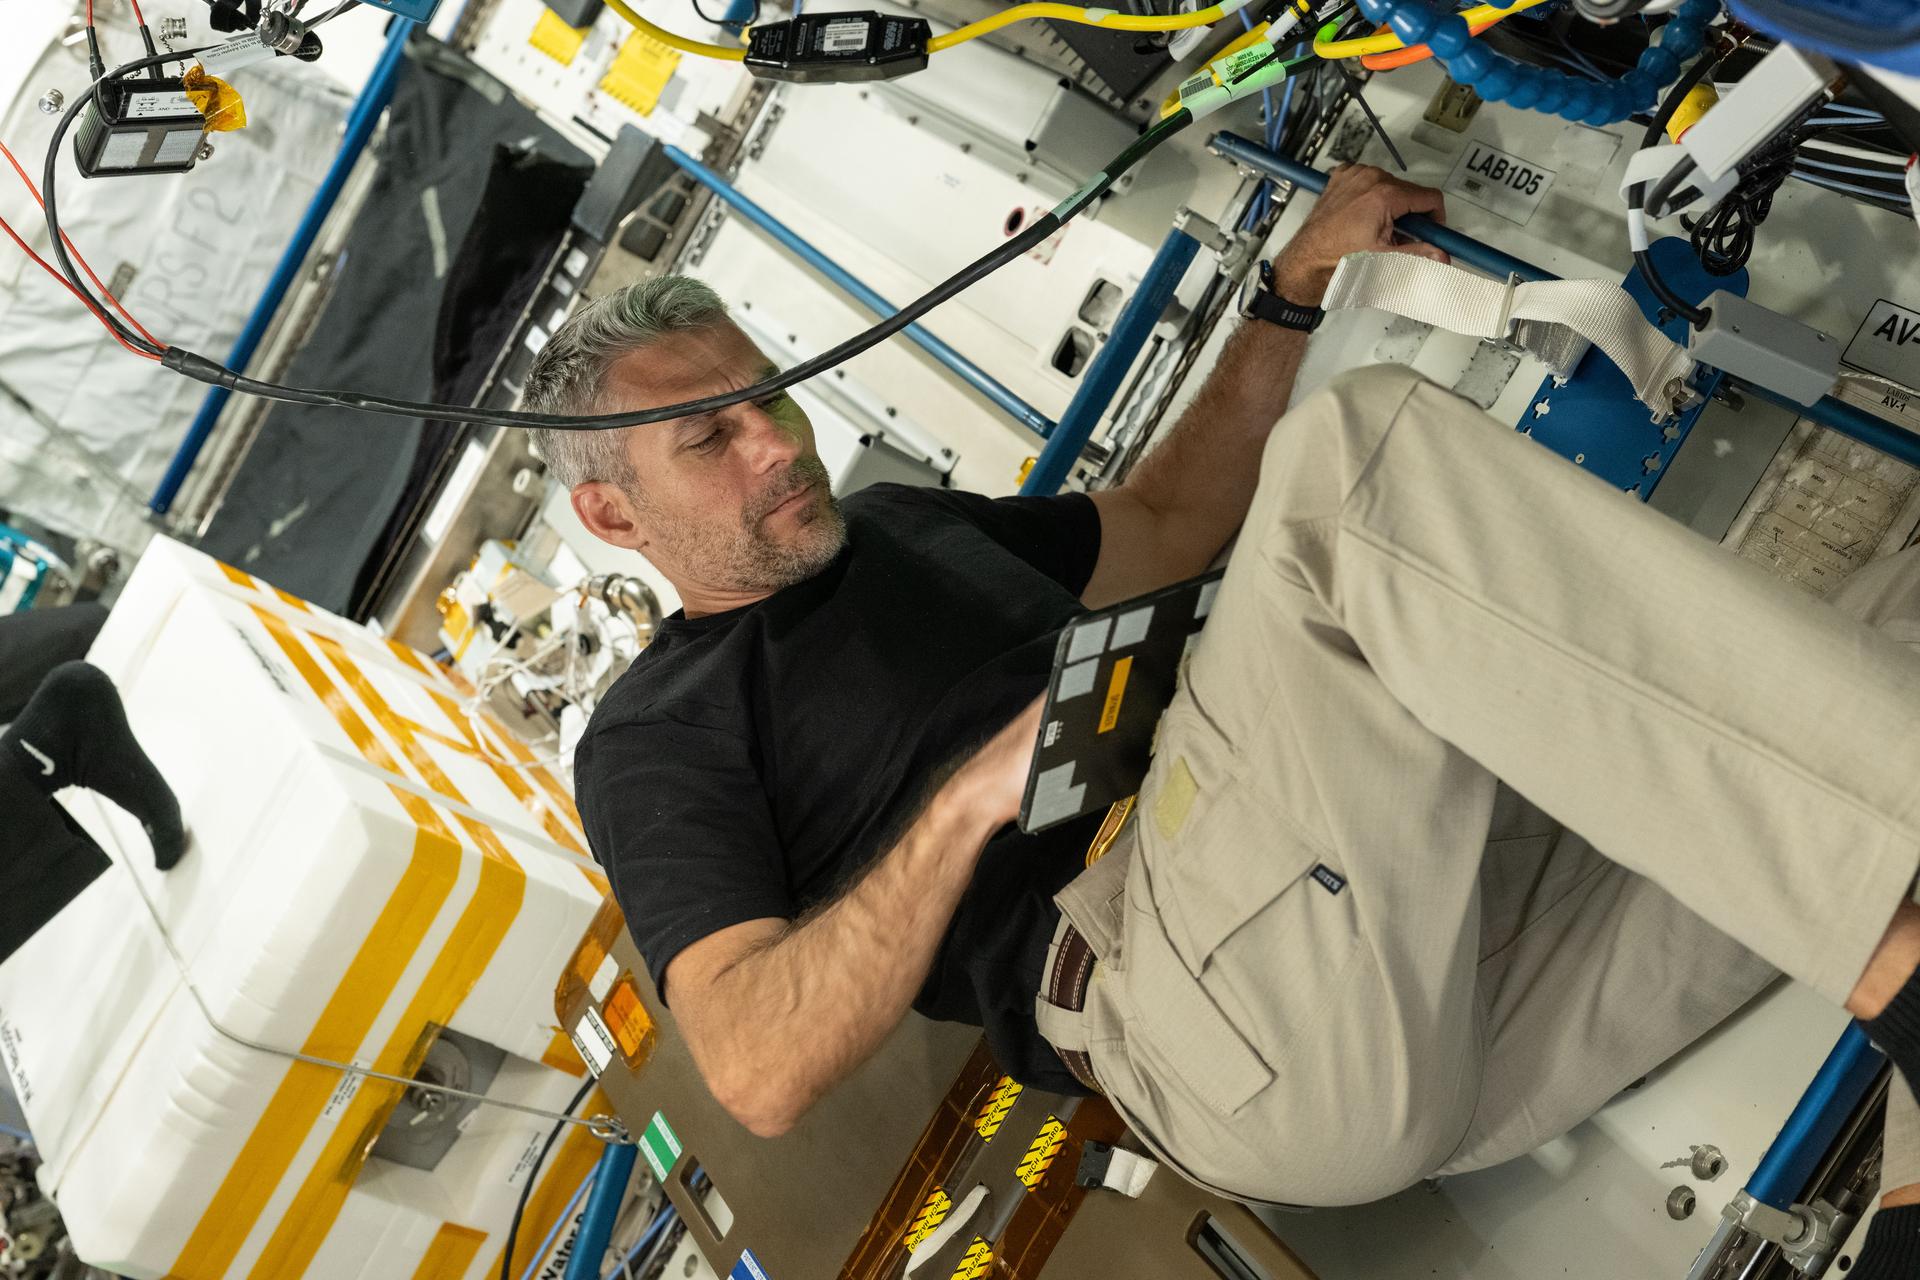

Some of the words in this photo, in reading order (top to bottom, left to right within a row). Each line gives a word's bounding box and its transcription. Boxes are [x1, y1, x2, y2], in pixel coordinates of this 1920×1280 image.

[1466, 147, 1544, 195] LAB1D5
[1881, 394, 1907, 413] AV-1
[981, 1103, 1001, 1133] HAZARD
[1023, 1157, 1040, 1182] PINCH
[1039, 1125, 1060, 1157] HAZARD
[929, 1194, 945, 1219] PINCH
[909, 1219, 930, 1250] HAZARD
[965, 1247, 986, 1278] HAZARD
